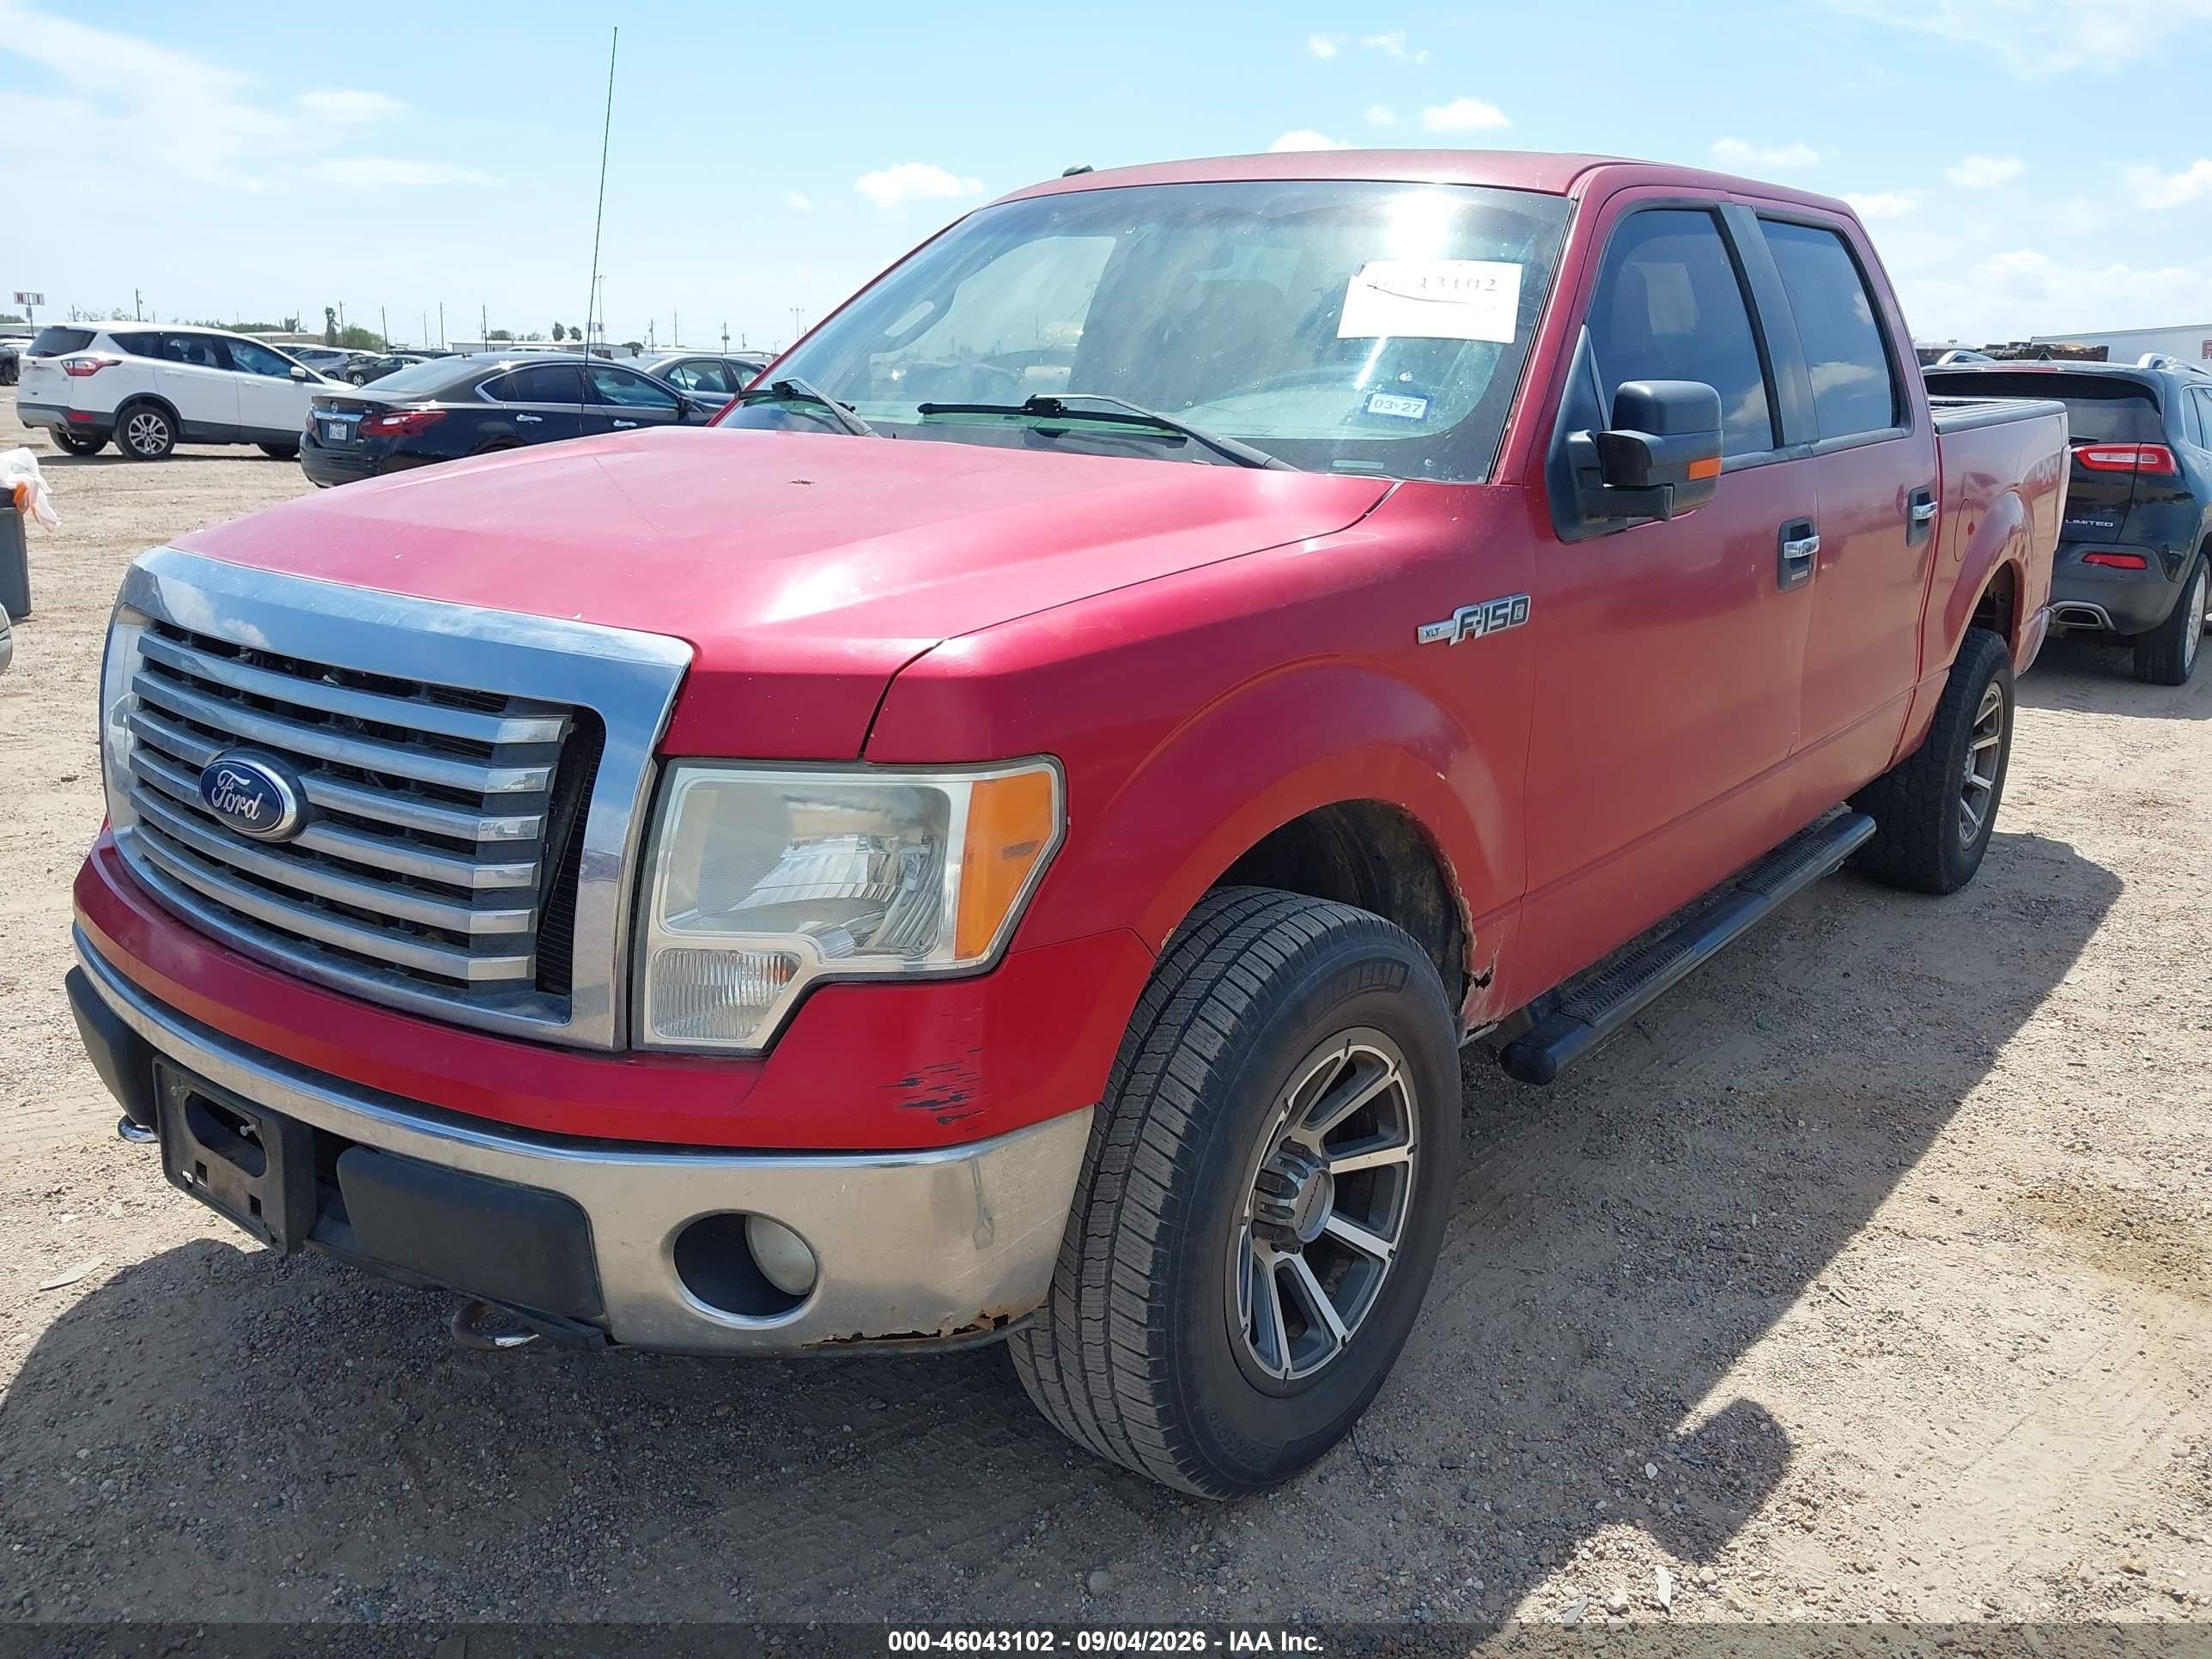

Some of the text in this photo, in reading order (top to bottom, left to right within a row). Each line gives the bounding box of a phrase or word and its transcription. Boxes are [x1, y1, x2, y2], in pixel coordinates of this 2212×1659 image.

[1374, 399, 1423, 413] 03 27
[2065, 519, 2114, 527] LIMITED
[1425, 628, 1440, 638] XLT
[211, 769, 263, 821] Ford
